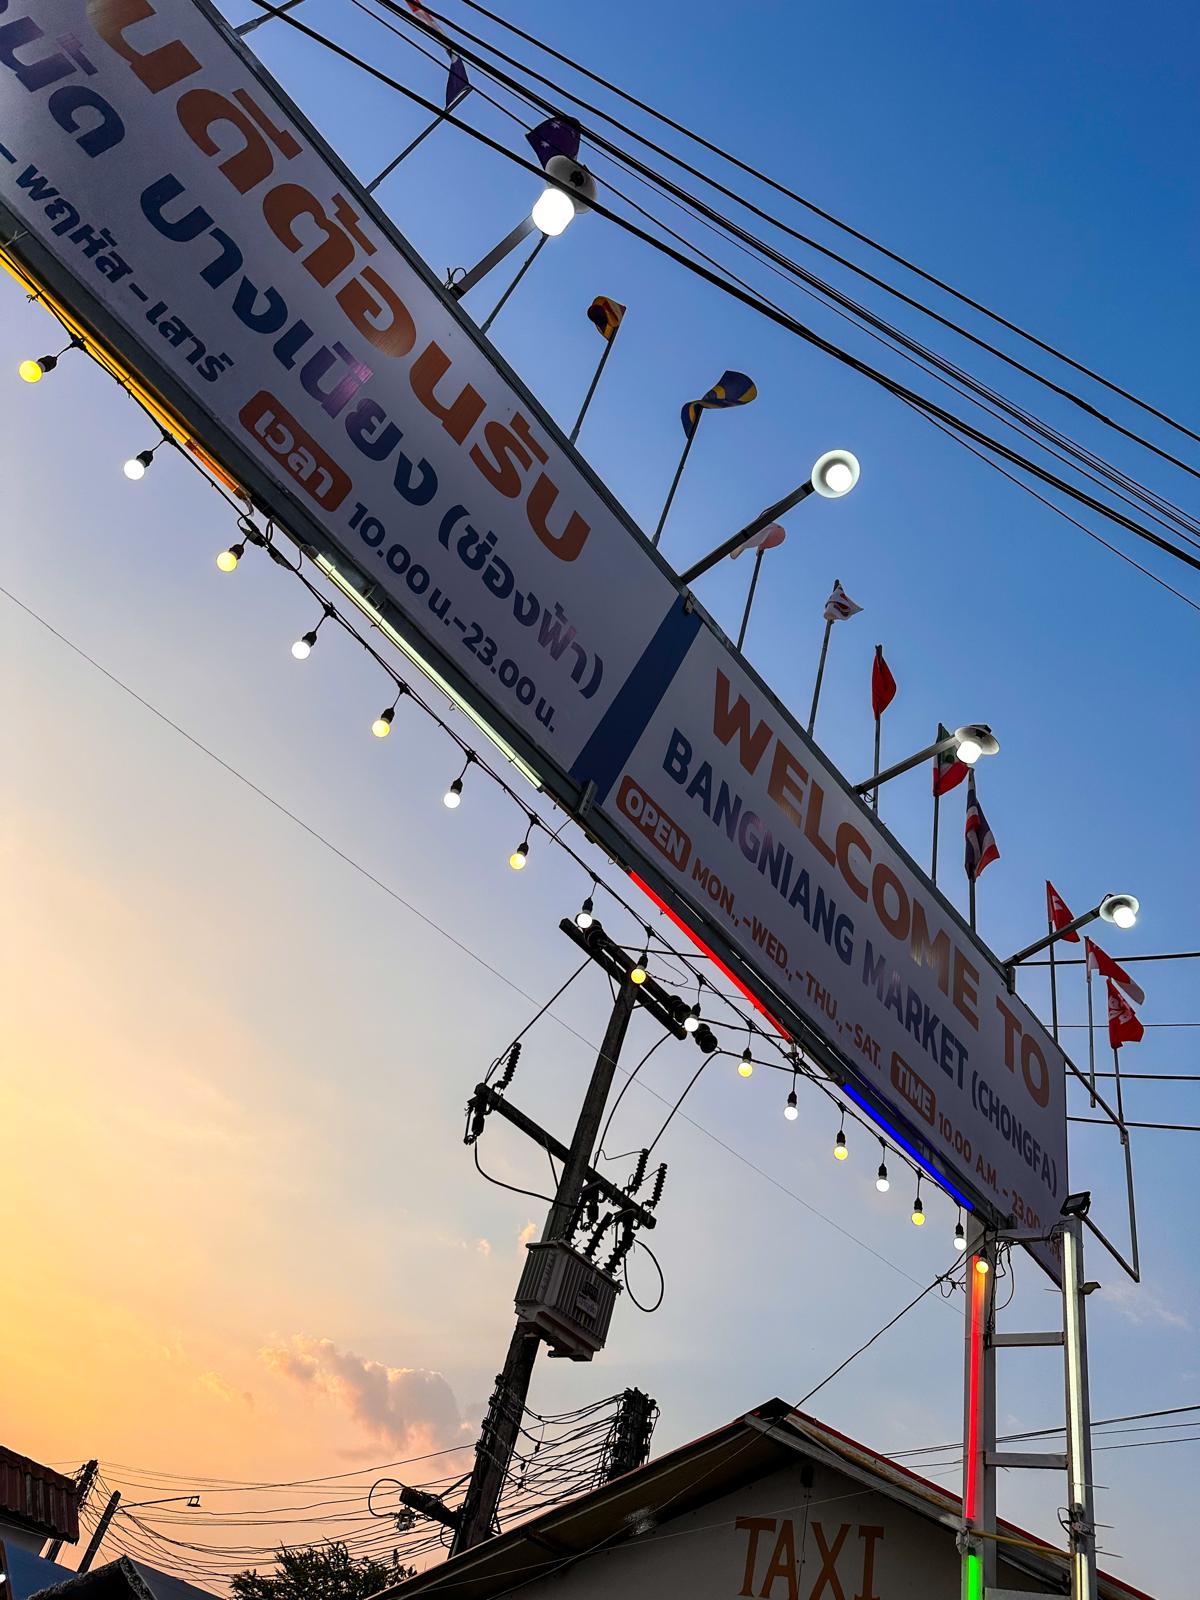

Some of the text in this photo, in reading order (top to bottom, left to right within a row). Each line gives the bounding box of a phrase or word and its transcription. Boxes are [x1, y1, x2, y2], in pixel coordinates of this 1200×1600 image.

[0, 0, 603, 699] นัด บางเนียง (ช่องฟ้า)
[254, 411, 334, 499] เวลา
[623, 787, 686, 865] OPEN
[898, 1062, 932, 1119] TIME
[939, 1112, 972, 1163] 10.00
[662, 727, 1058, 1198] BANGNIANG MARKET (CHONGFA)
[713, 667, 1049, 1109] WELCOME TO
[735, 1515, 885, 1600] TAXI
